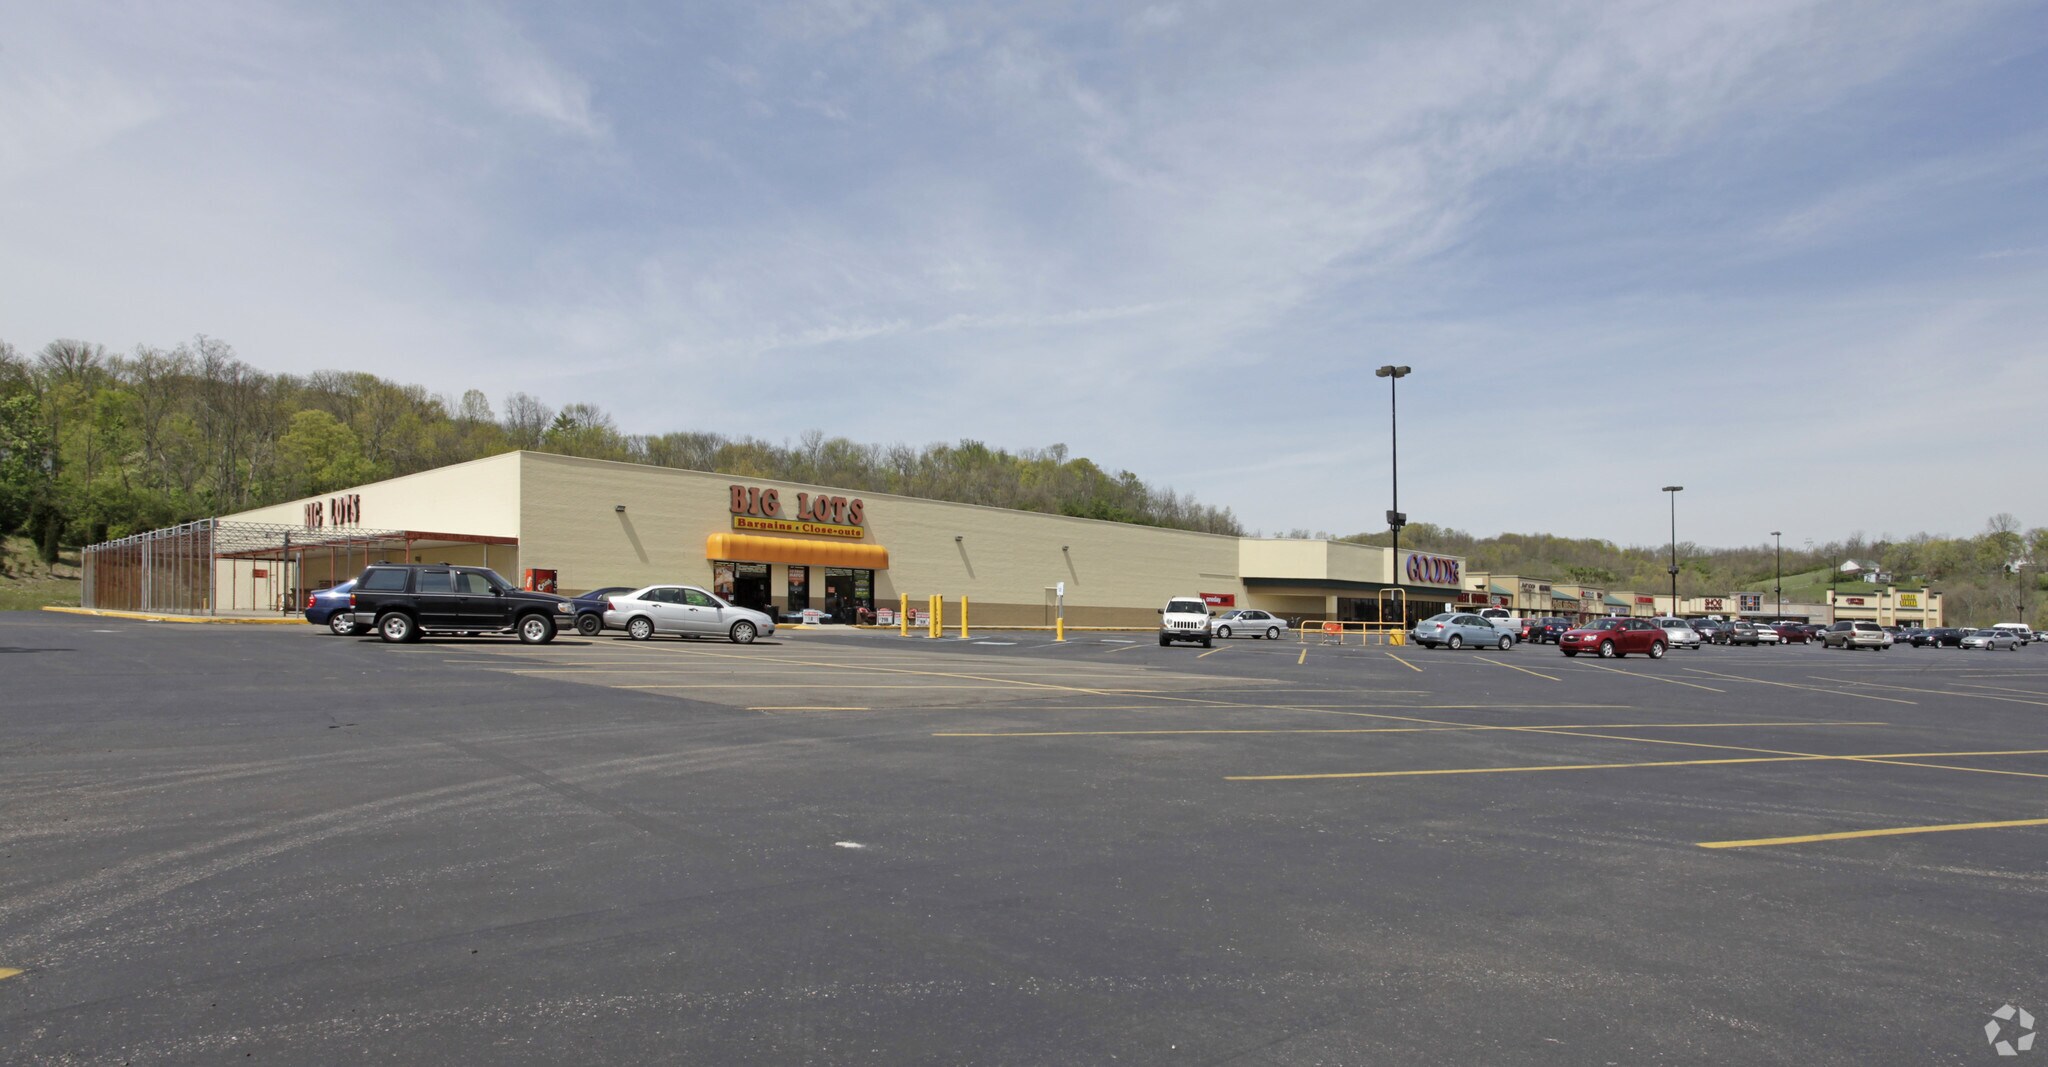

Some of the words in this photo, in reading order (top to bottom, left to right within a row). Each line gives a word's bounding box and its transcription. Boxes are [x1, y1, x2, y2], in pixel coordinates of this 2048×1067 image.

[304, 501, 323, 529] BIG
[329, 494, 361, 526] LOTS
[730, 485, 780, 517] BIG
[797, 492, 863, 525] LOTS
[737, 518, 792, 531] Bargains
[802, 523, 861, 536] Close-outs
